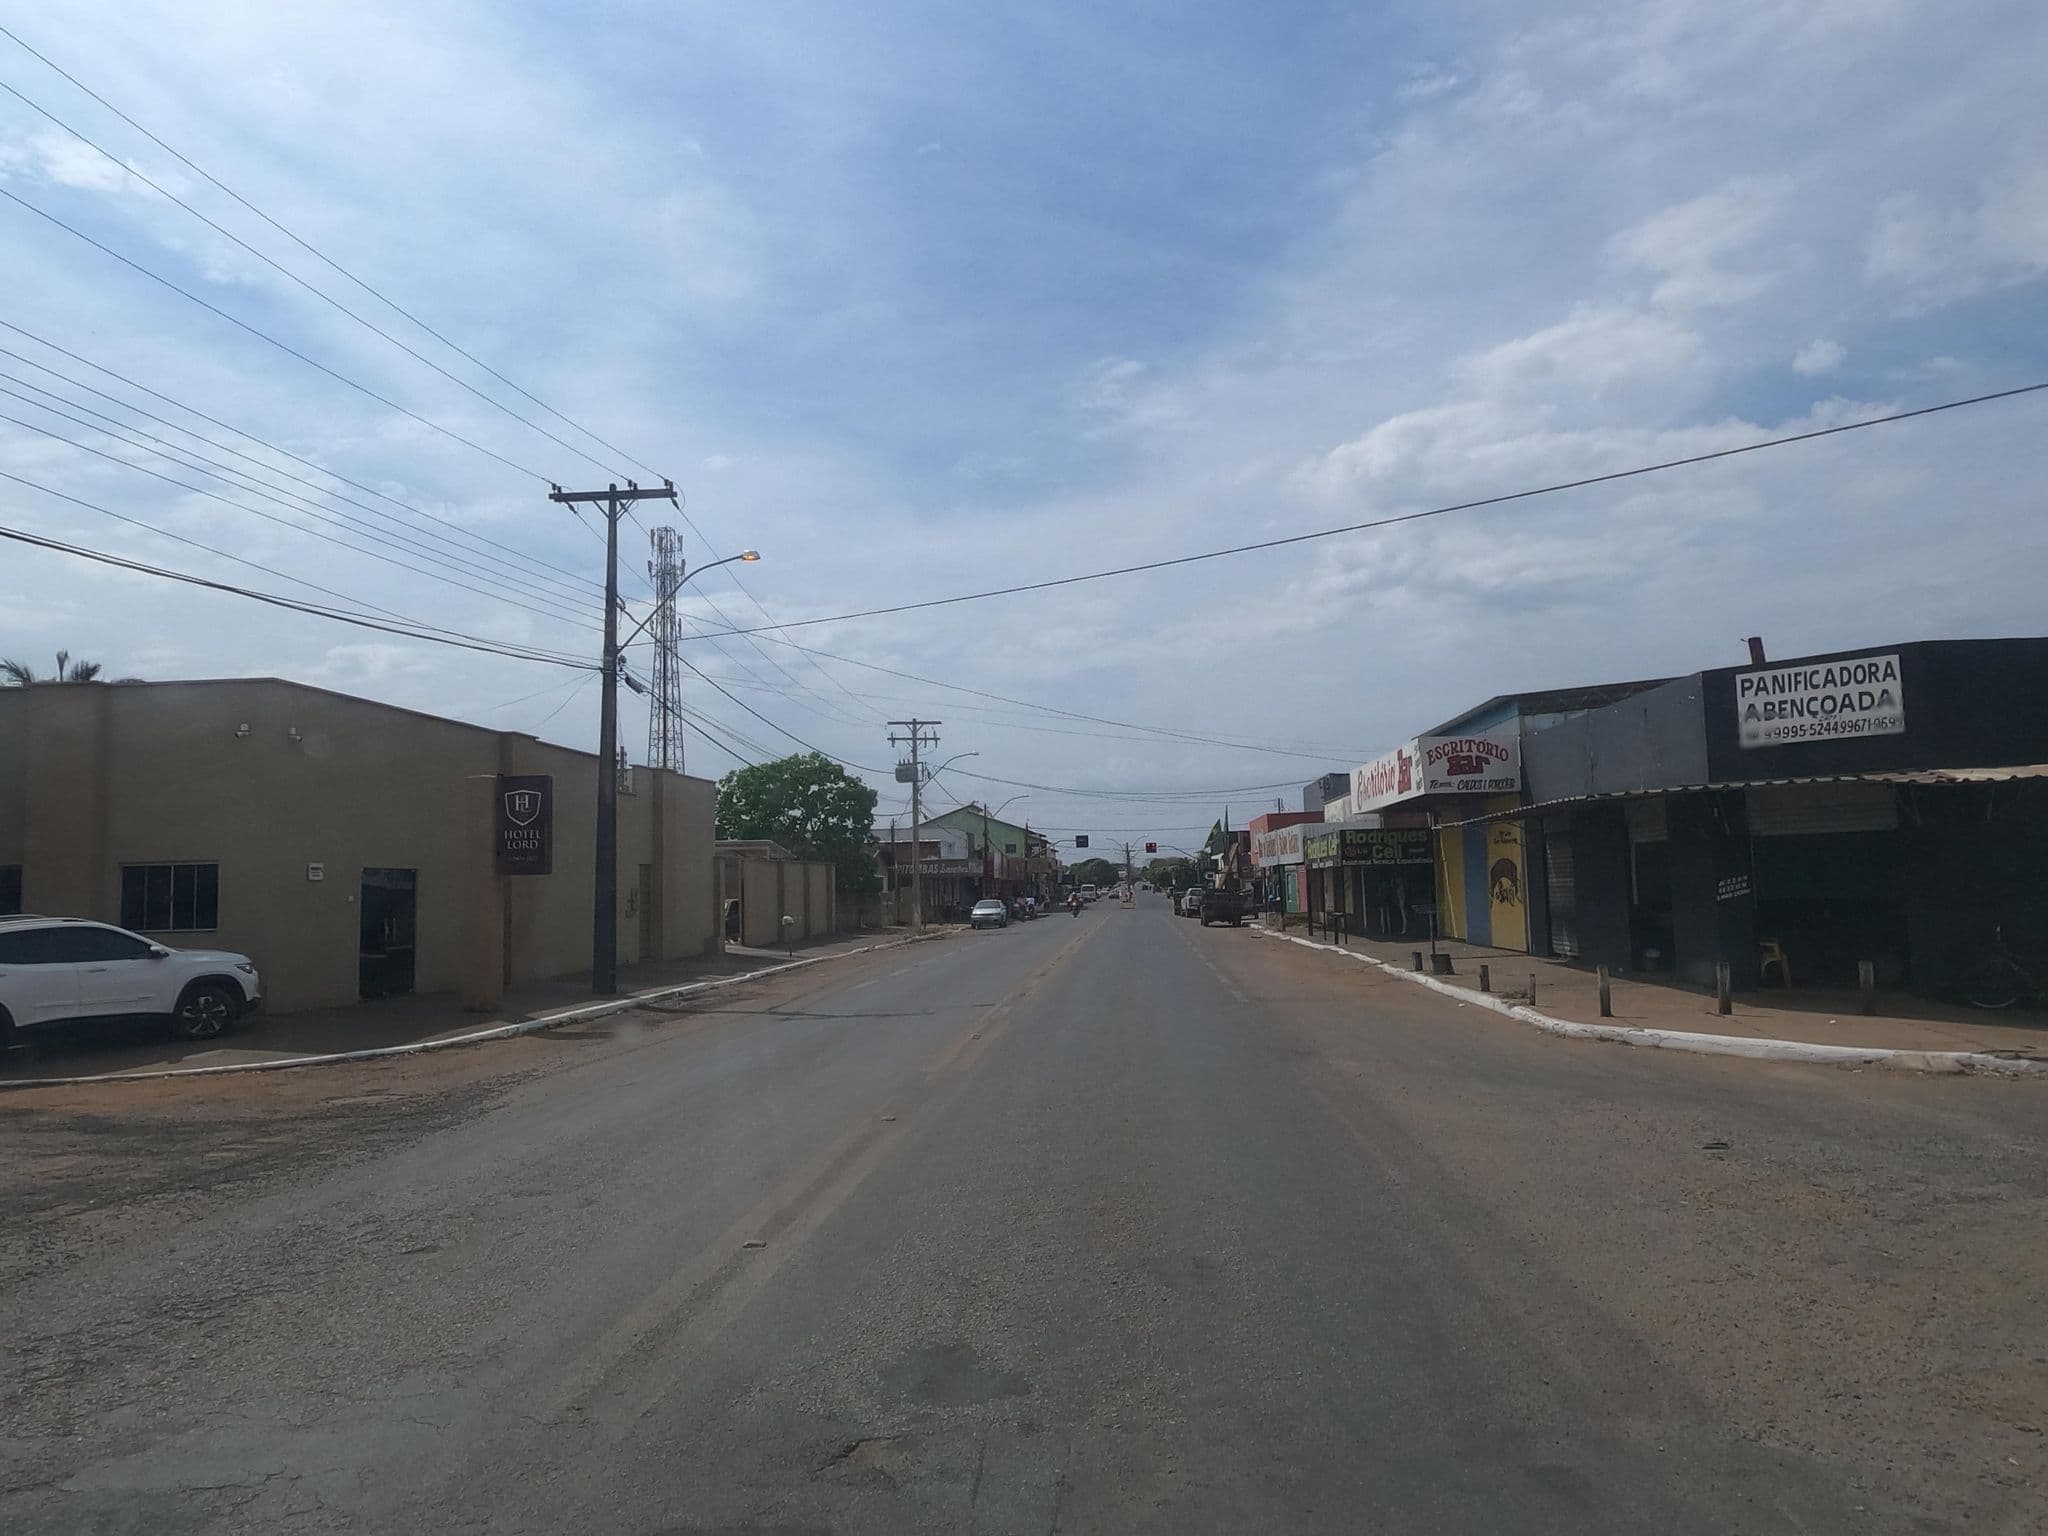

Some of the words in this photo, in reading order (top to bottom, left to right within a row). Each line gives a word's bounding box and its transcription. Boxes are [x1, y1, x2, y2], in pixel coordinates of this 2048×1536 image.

[1740, 661, 1898, 697] PANIFICADORA
[1744, 689, 1895, 722] ABENÇOADA
[1426, 739, 1509, 766] ESCRITÓRIO
[504, 830, 542, 839] HOTEL
[1344, 830, 1428, 844] Rodrigues
[507, 840, 539, 850] LORD
[1372, 845, 1402, 859] Cell
